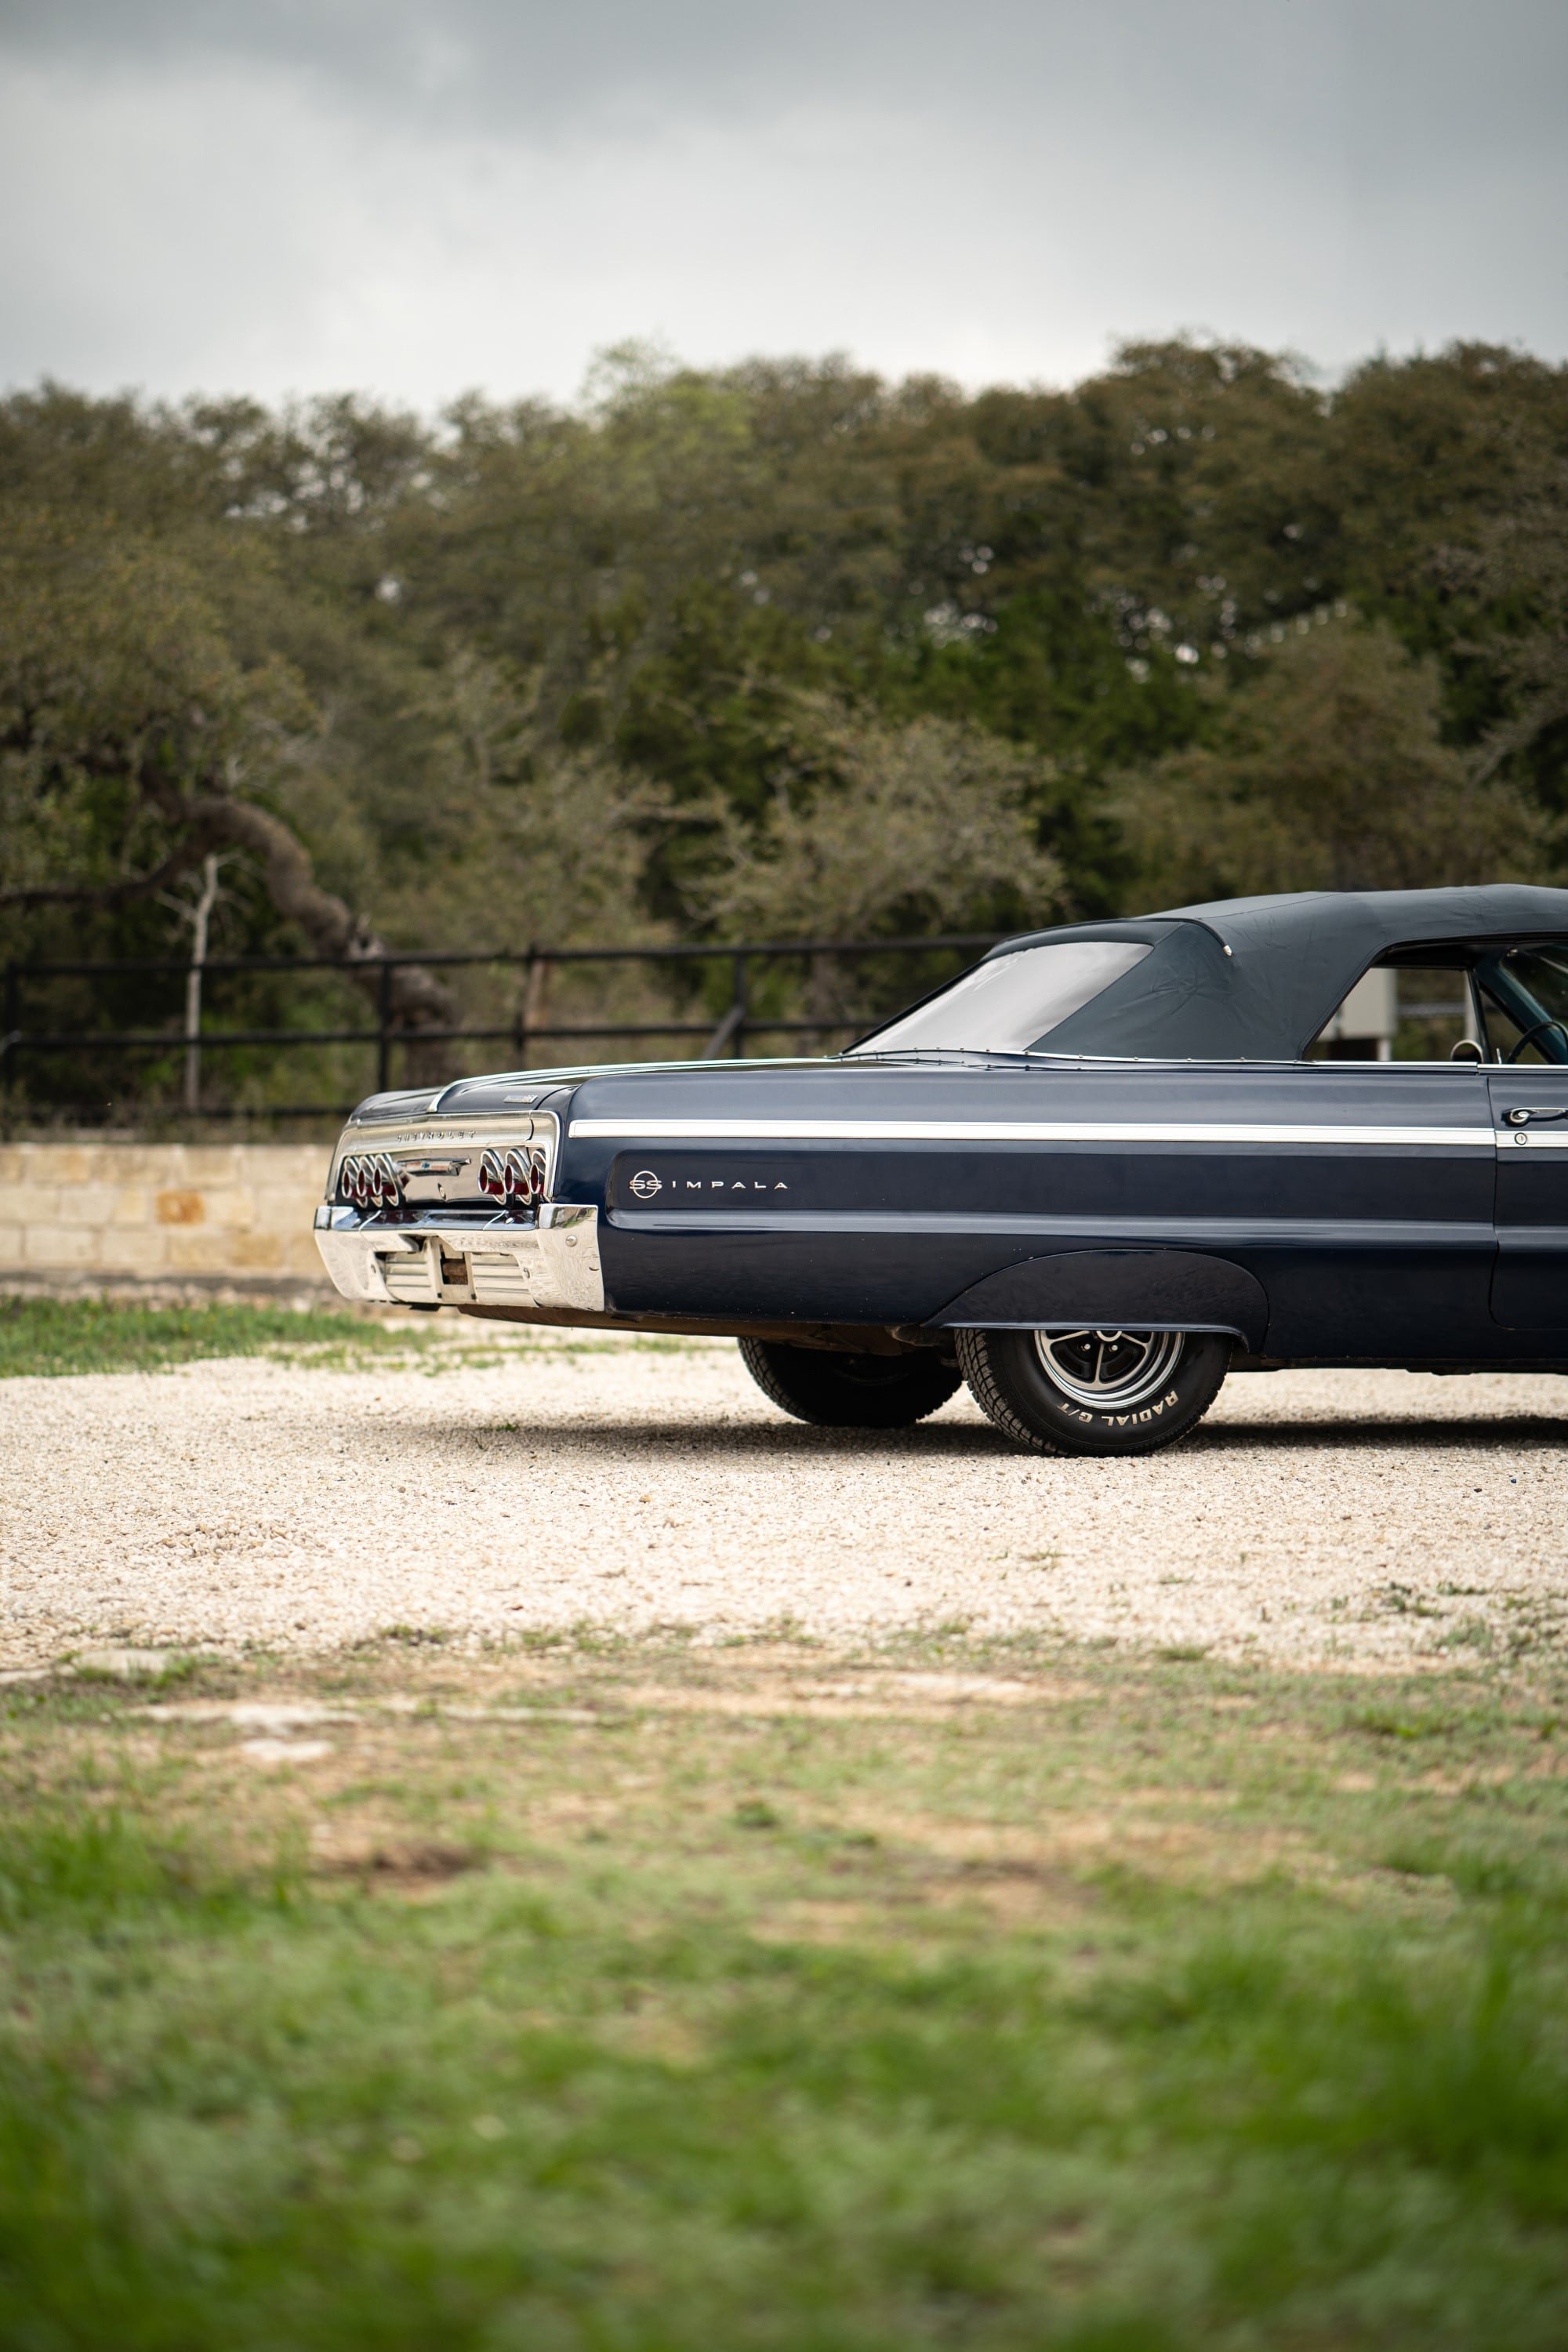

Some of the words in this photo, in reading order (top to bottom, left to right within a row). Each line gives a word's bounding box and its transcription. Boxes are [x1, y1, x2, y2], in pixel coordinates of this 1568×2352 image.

[672, 1181, 789, 1189] IMPALA
[1057, 1402, 1094, 1424] G/T
[1101, 1390, 1179, 1427] RADIAL
